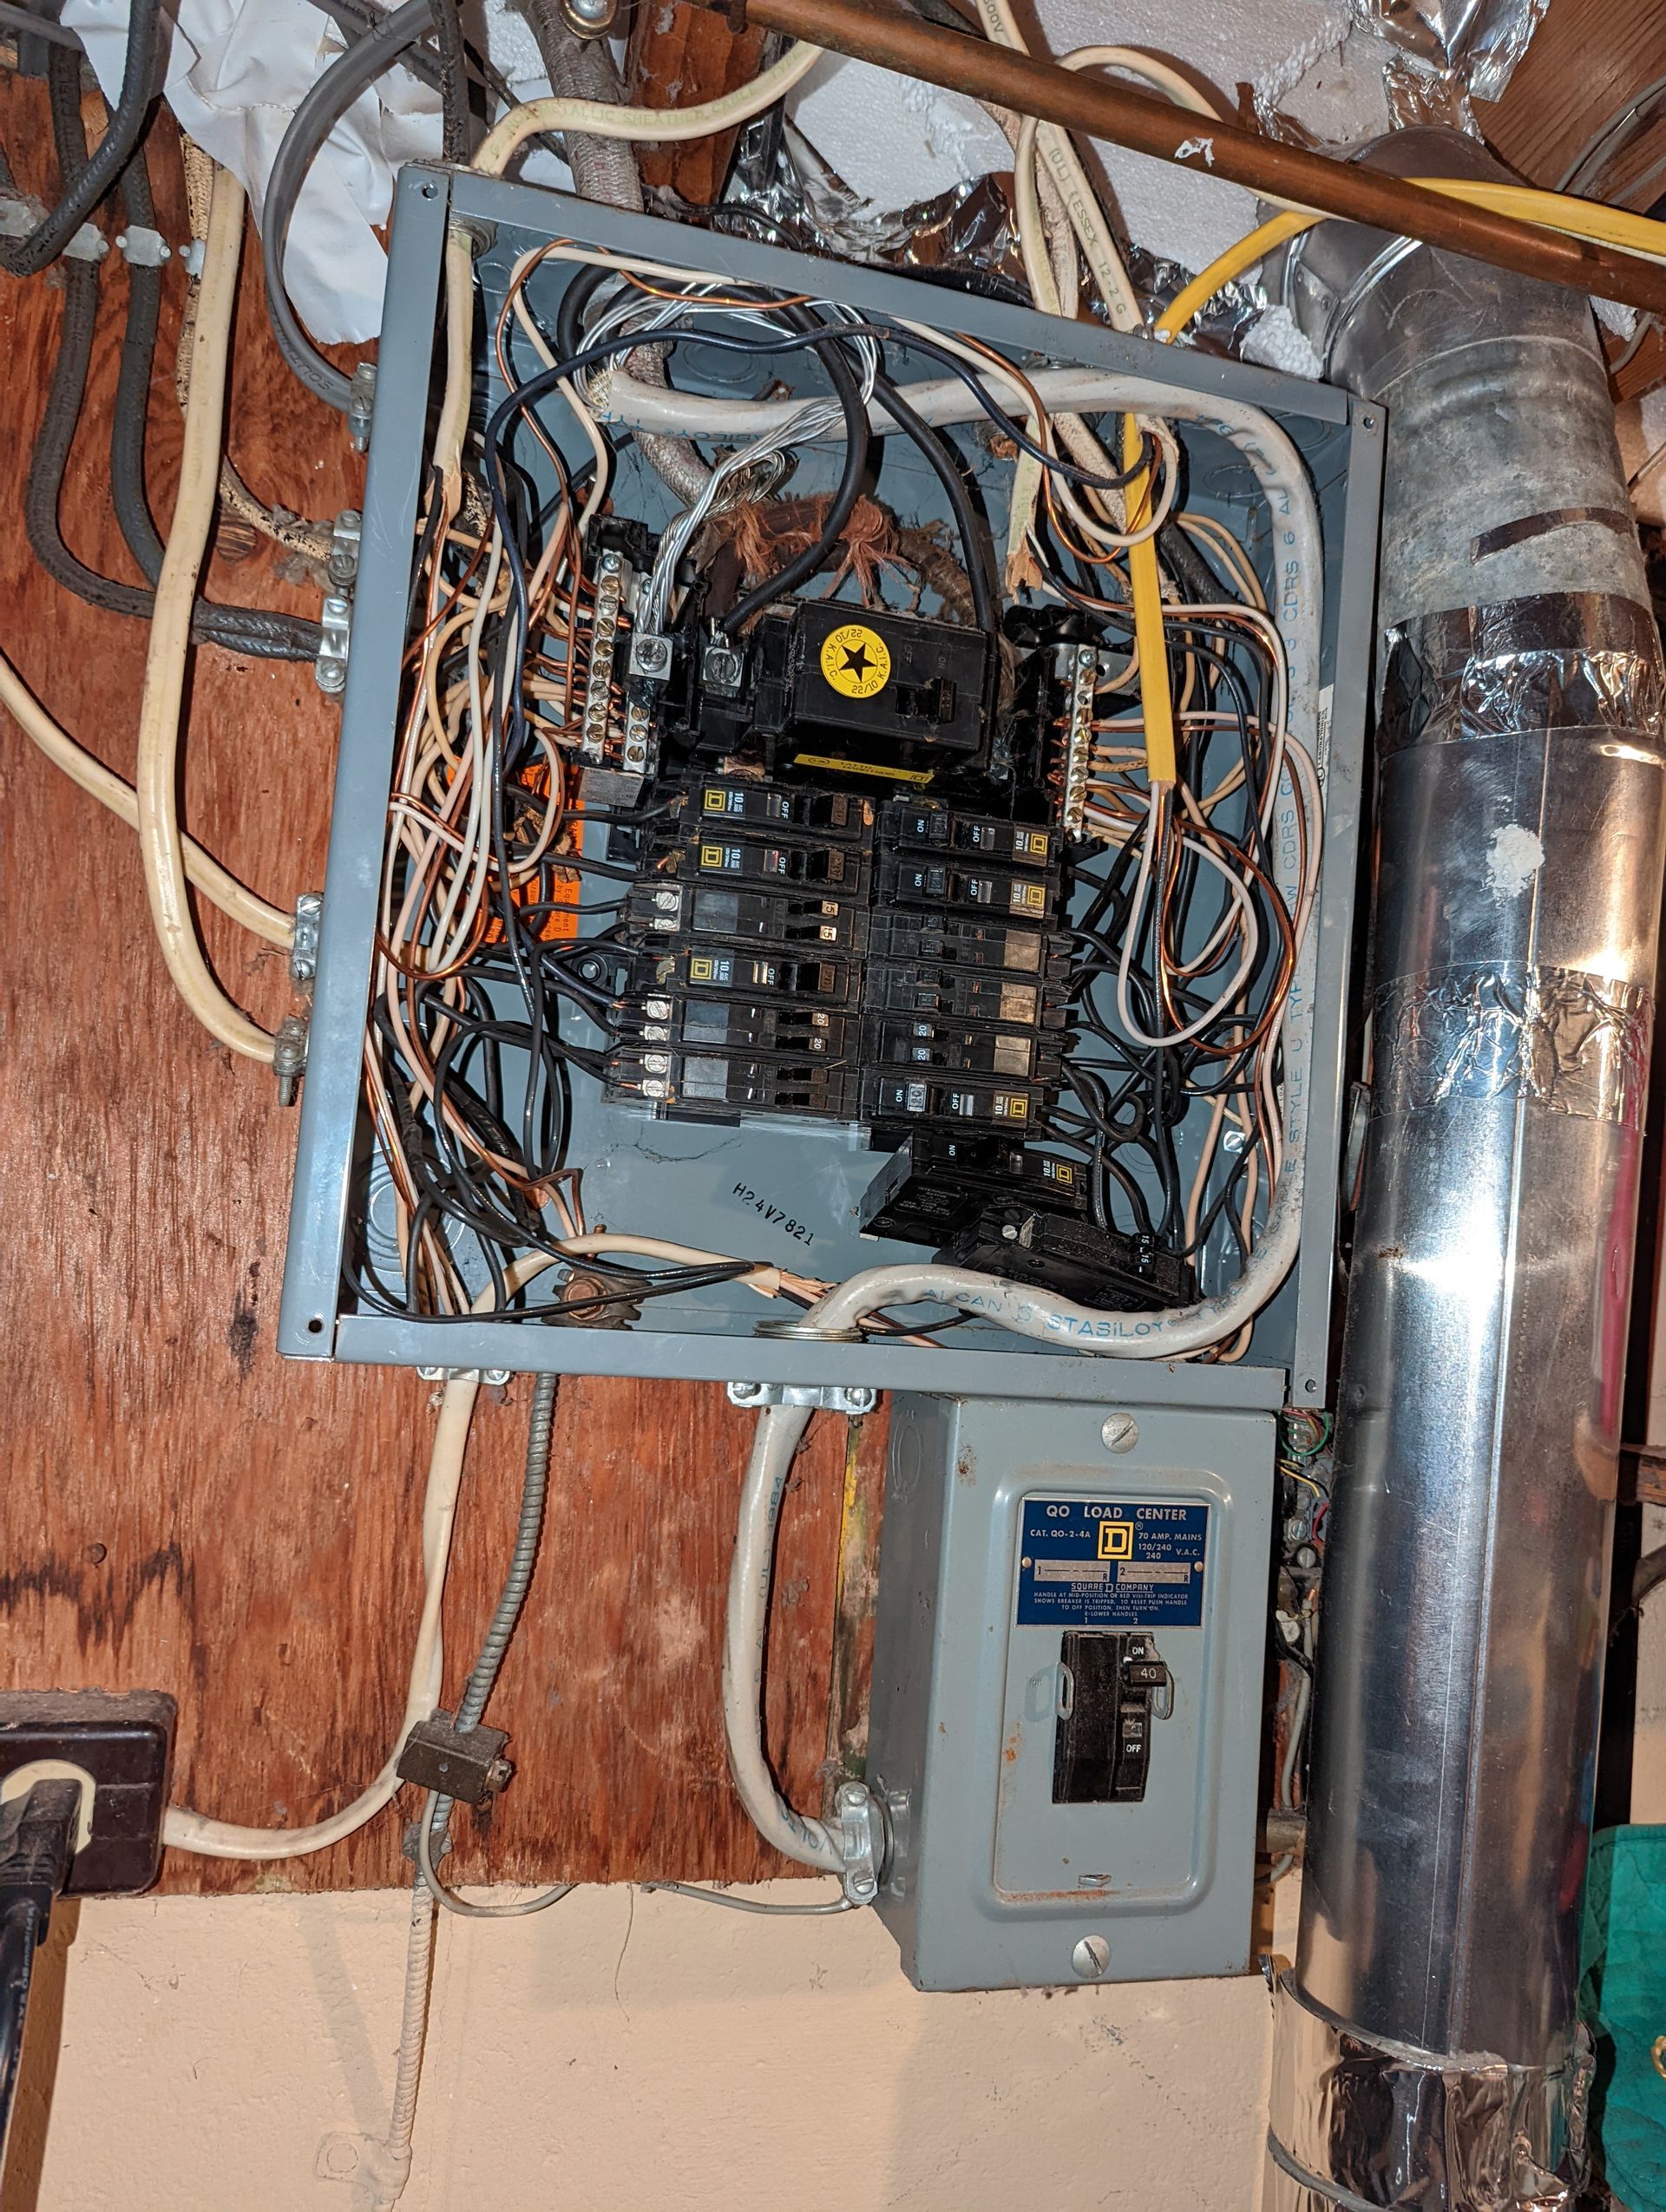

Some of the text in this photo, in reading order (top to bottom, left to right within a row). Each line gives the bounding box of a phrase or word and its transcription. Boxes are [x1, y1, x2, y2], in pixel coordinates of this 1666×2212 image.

[982, 0, 1004, 34] 00V
[1278, 488, 1292, 515] AL
[1283, 531, 1296, 546] 6
[1283, 560, 1299, 623] CDRS
[836, 628, 863, 645] 22/10
[851, 681, 879, 695] 22/10
[917, 819, 925, 833] ON
[1281, 809, 1295, 870] CDRS
[915, 874, 922, 887] ON
[562, 888, 573, 932] Equment
[825, 902, 836, 915] 15
[823, 926, 834, 939] 15
[817, 1012, 825, 1025] 20
[918, 1025, 927, 1037] 20
[813, 1037, 822, 1050] 20
[1291, 1038, 1302, 1052] U
[918, 1050, 926, 1061] 20
[895, 1089, 903, 1103] ON
[1289, 1068, 1302, 1142] STYLE
[949, 1144, 956, 1156] ON
[732, 1182, 815, 1247] H24V7821
[1141, 1235, 1150, 1245] 15
[1141, 1254, 1149, 1265] 15
[926, 1288, 1002, 1312] ALCAN
[1046, 1505, 1187, 1521] QO LOAD CENTER
[1030, 1529, 1048, 1538] CAT.
[1138, 1542, 1171, 1552] 120/240
[1071, 1582, 1154, 1593] SQUARE D COMPANY
[1131, 1646, 1145, 1655] ON
[1140, 1667, 1157, 1679] 40
[1125, 1744, 1142, 1753] OFF
